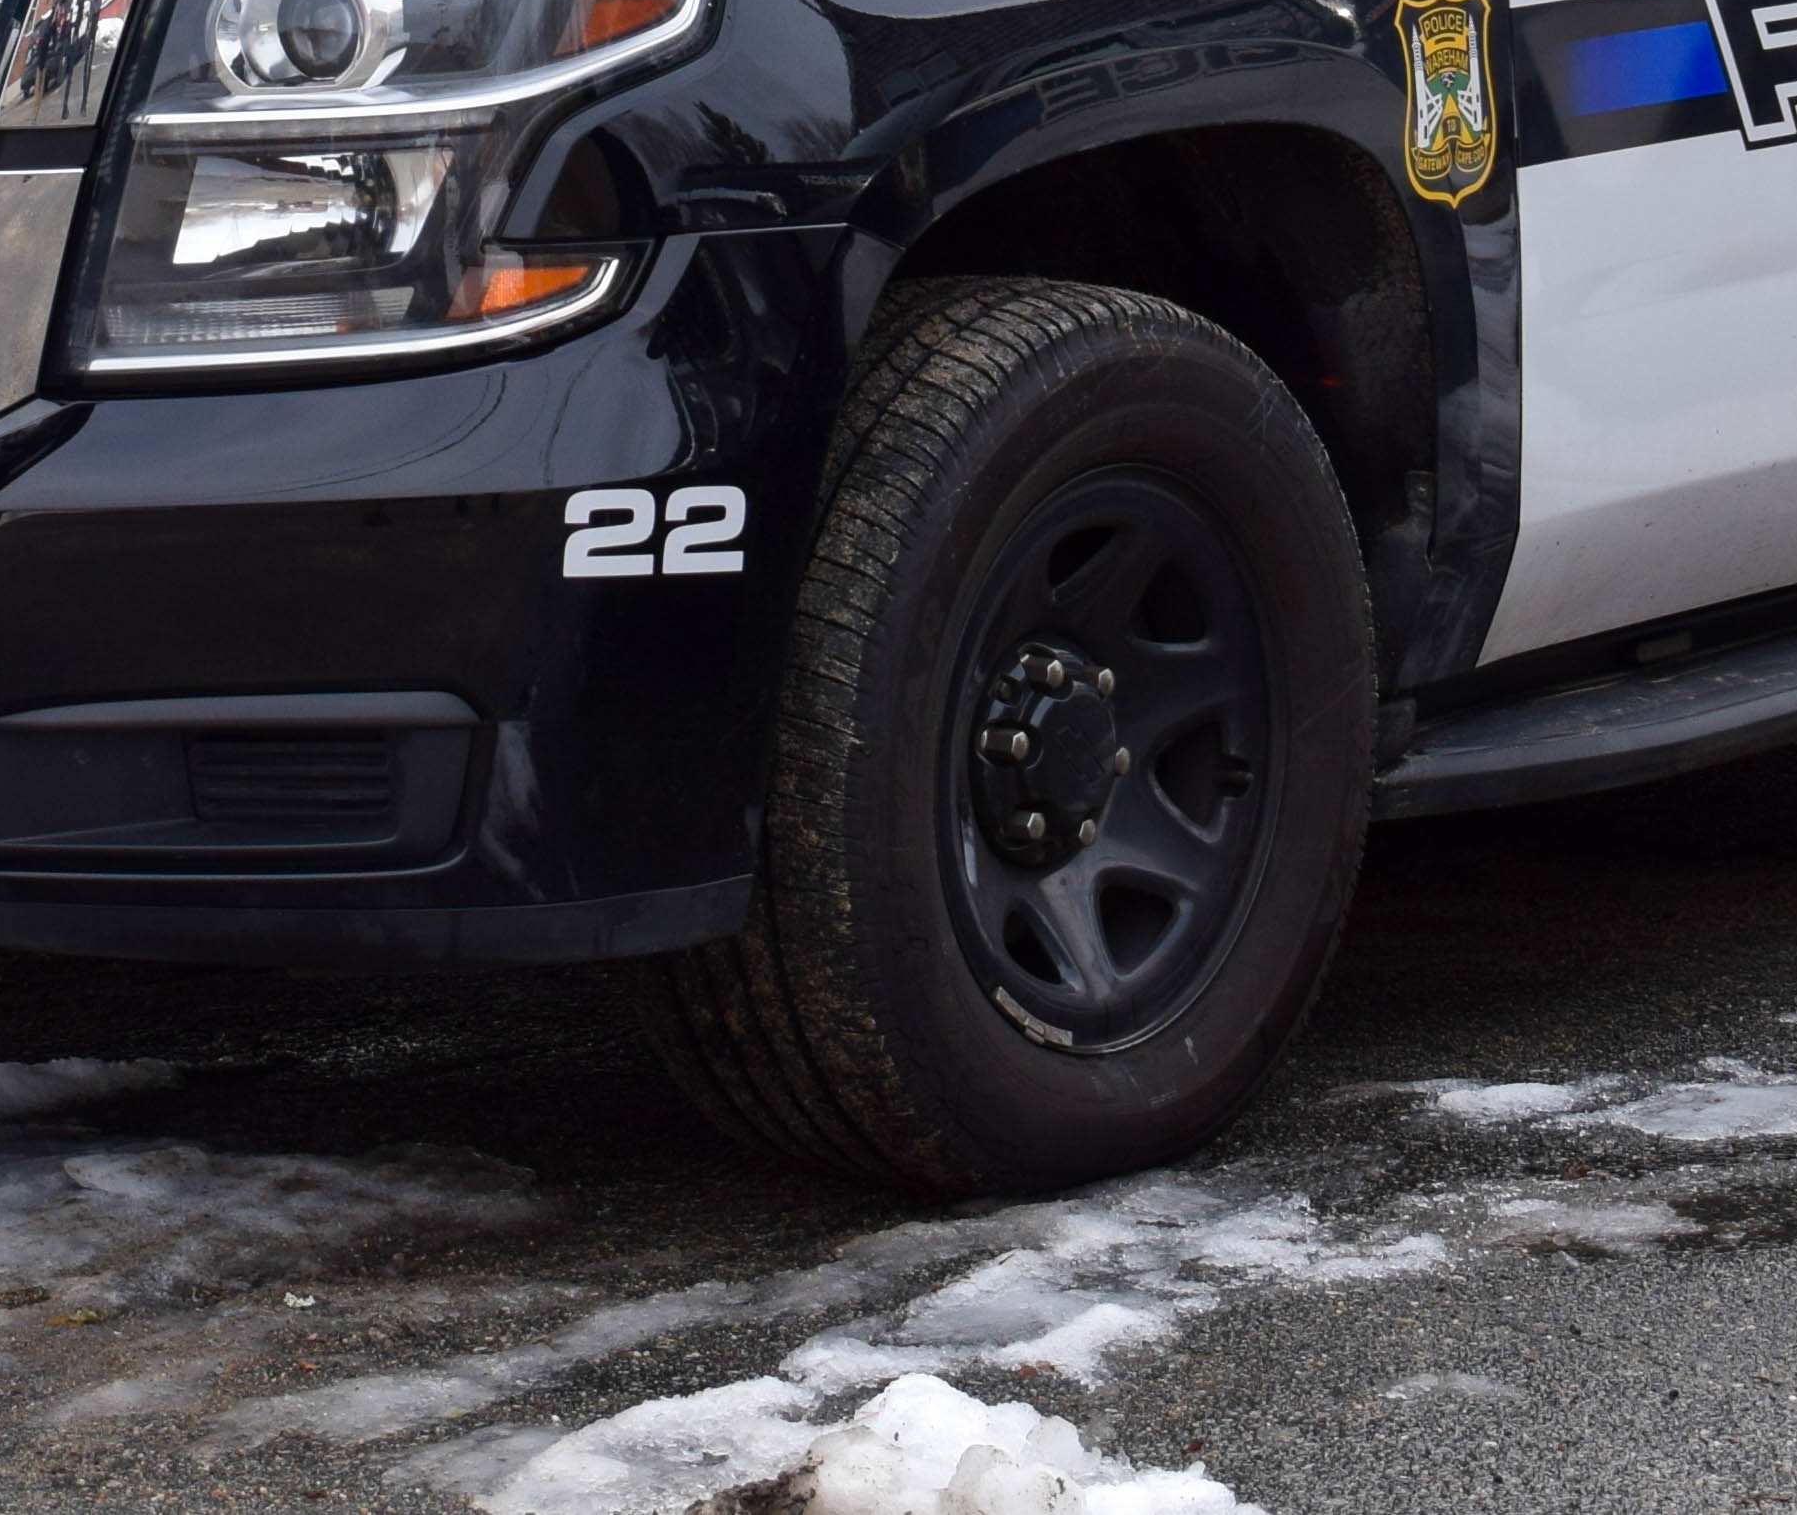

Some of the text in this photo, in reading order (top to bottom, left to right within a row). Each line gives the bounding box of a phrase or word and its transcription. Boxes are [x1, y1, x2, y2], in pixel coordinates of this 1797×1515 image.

[1423, 13, 1463, 37] POLICE
[1425, 48, 1469, 72] WAREHAM
[563, 485, 746, 577] 22
